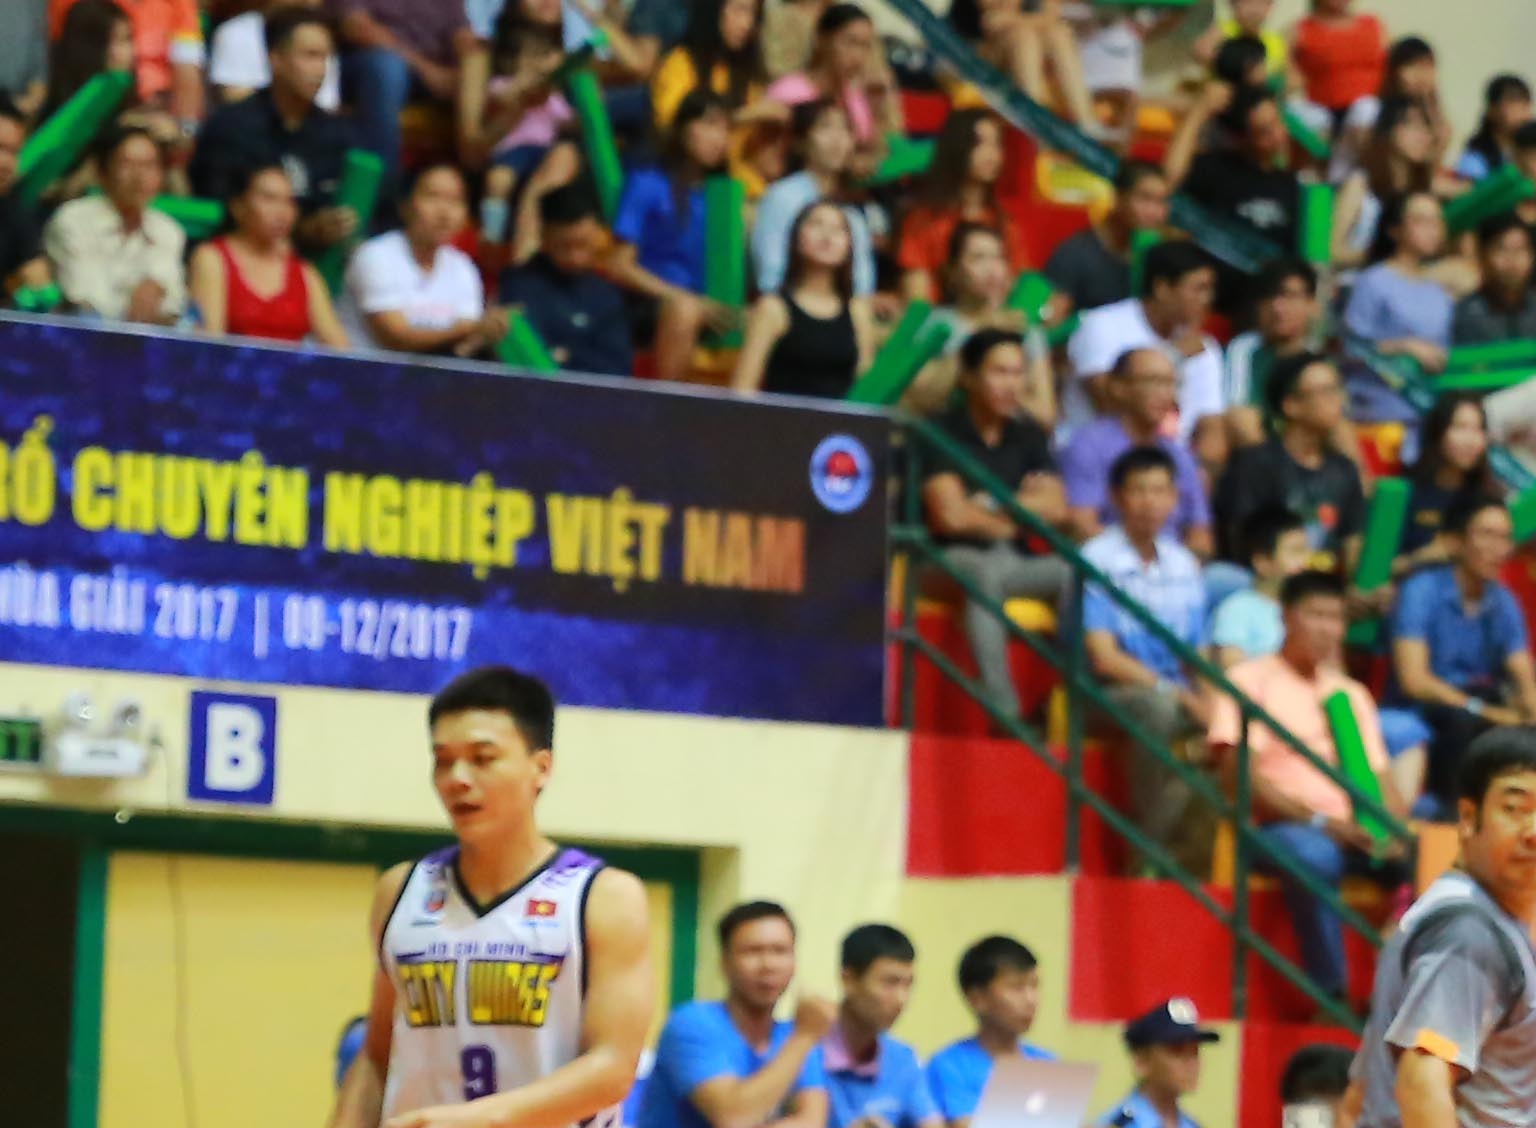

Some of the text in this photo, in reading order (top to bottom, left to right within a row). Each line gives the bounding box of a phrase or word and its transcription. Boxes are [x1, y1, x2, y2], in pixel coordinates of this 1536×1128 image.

[71, 444, 310, 550] CHUYÊN
[322, 469, 534, 581] NGHIỆP
[546, 485, 670, 593] VIỆT
[683, 506, 806, 594] NAM
[153, 581, 238, 641] 2017
[283, 593, 473, 662] 09-12/2017
[204, 702, 266, 793] B
[461, 1045, 497, 1101] 9
